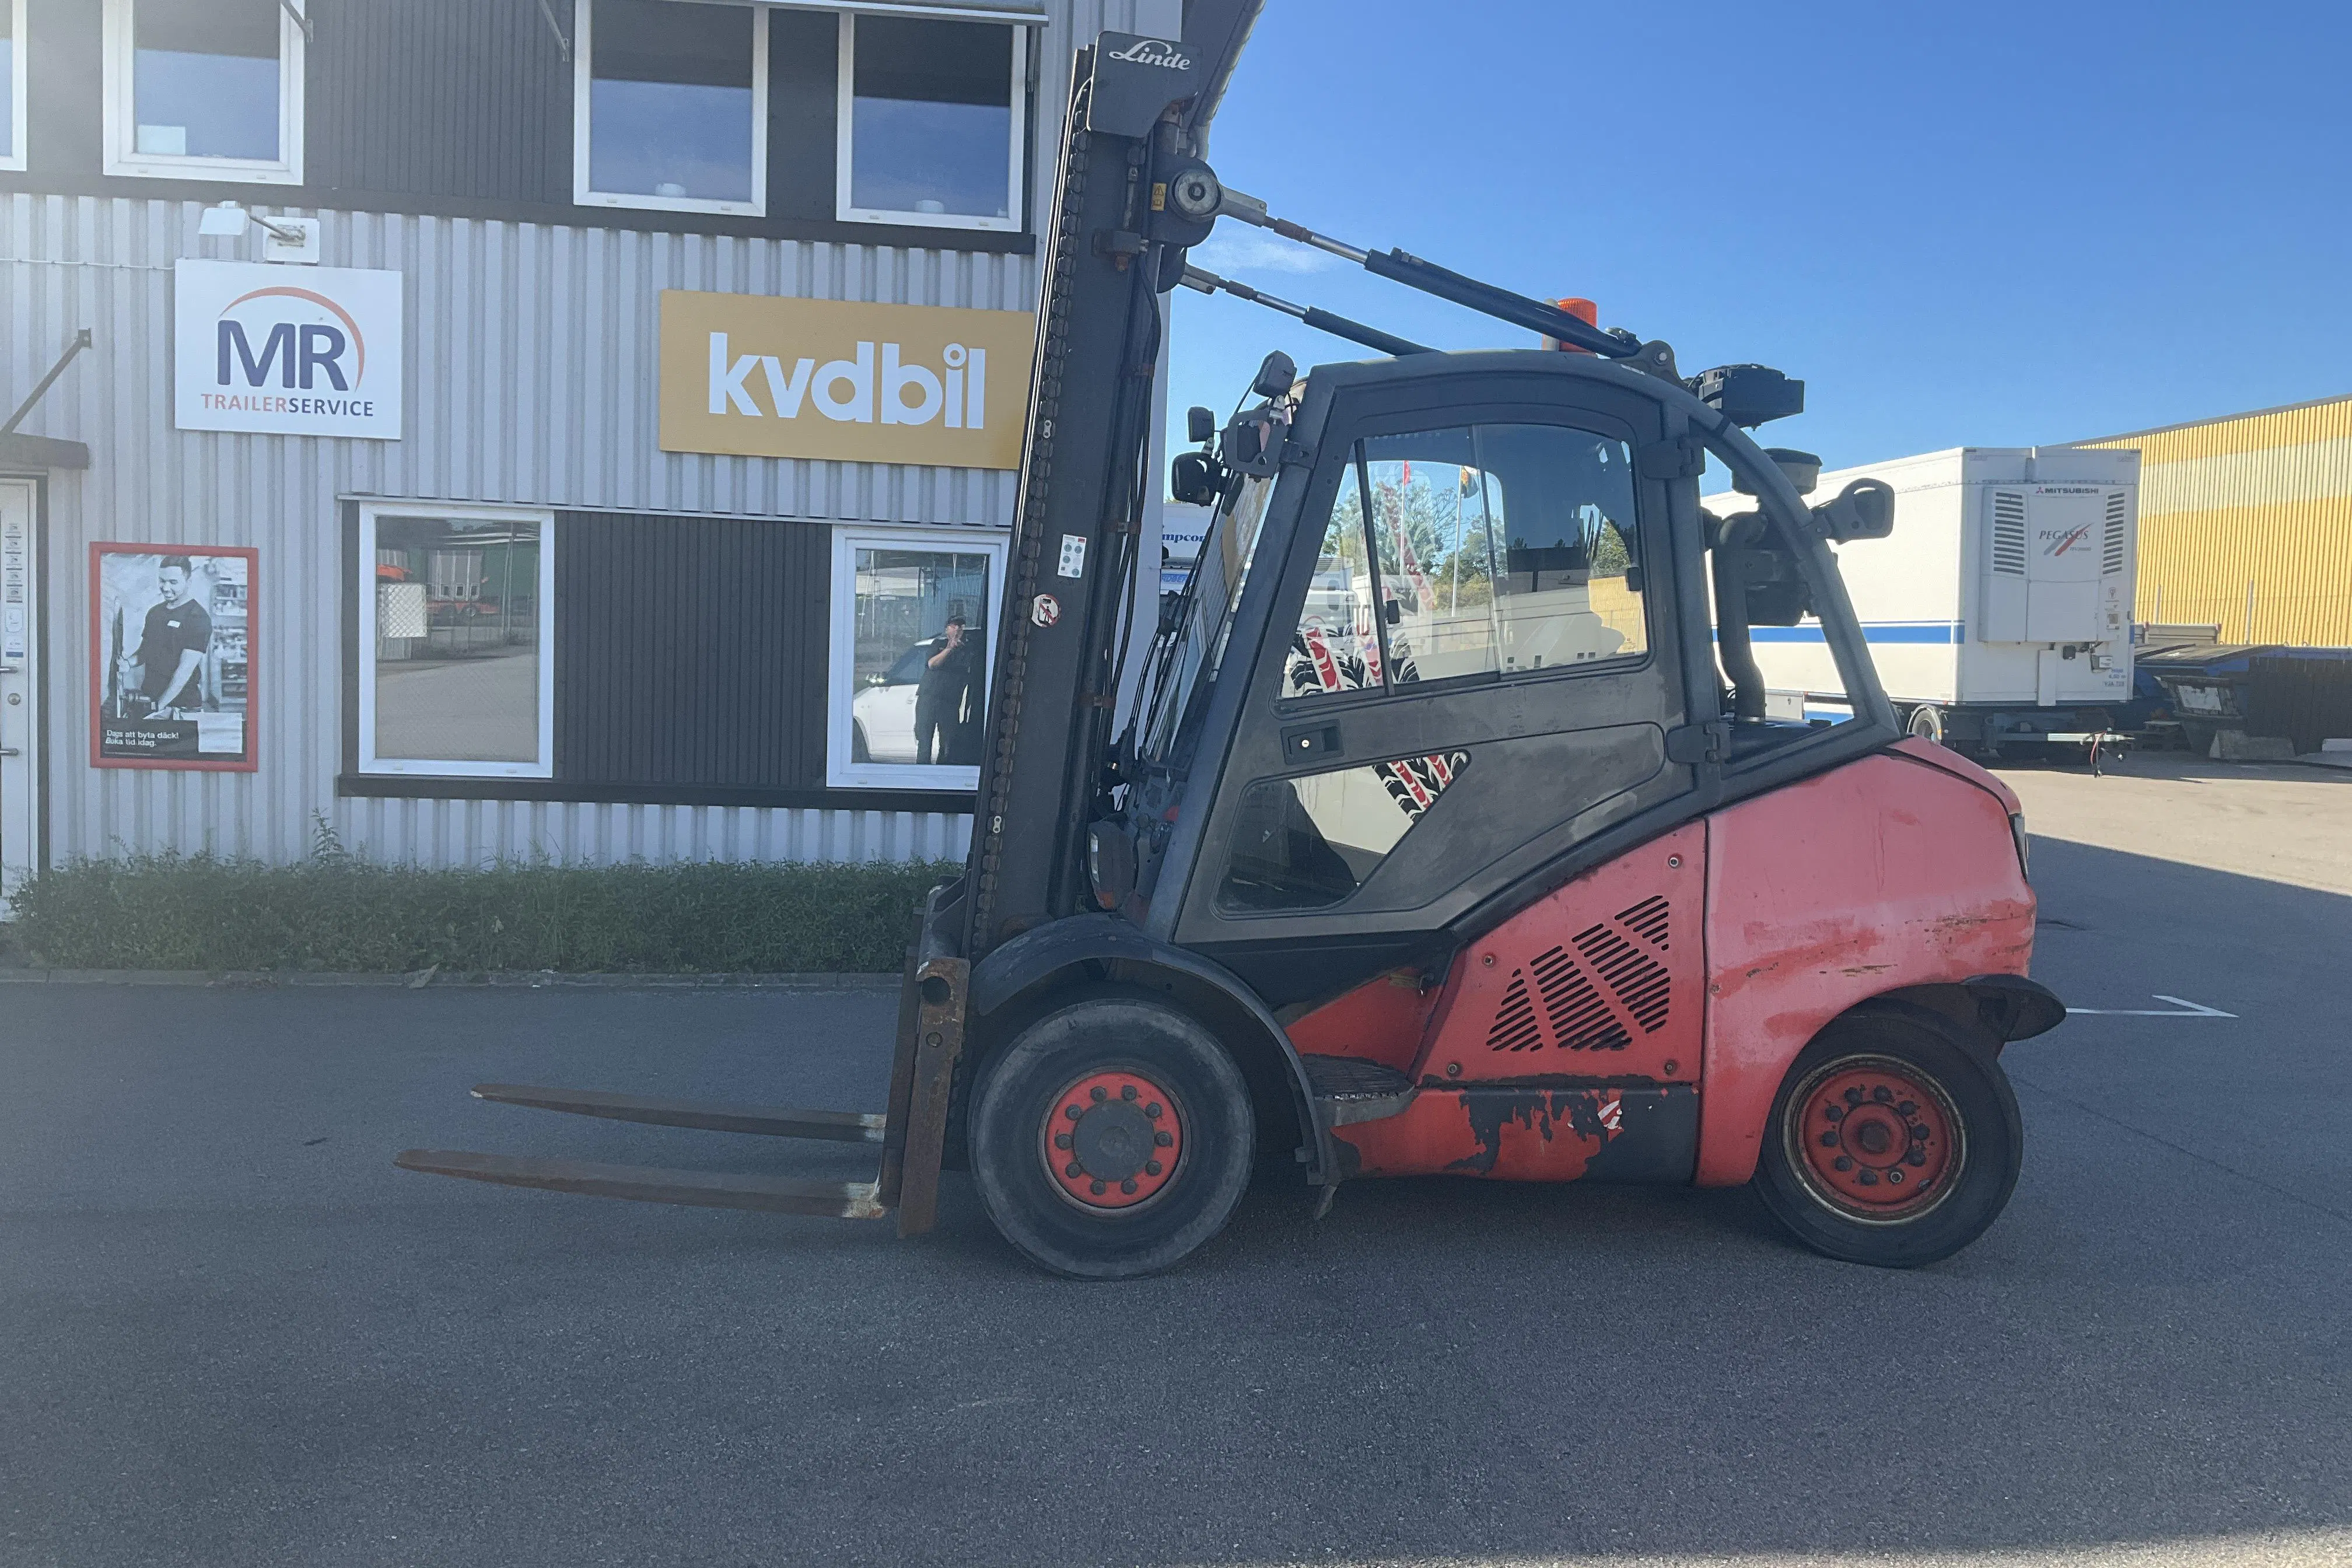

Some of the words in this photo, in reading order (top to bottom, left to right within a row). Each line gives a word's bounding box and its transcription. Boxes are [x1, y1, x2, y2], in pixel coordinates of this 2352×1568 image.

[1109, 40, 1191, 70] Linde
[217, 320, 349, 391] MR
[709, 332, 985, 429] kvdbil
[201, 393, 373, 416] TRAILERSERVICE
[2039, 530, 2089, 540] PEGASUS
[106, 737, 123, 745] Boka
[107, 729, 123, 738] Dags
[138, 731, 155, 741] byta
